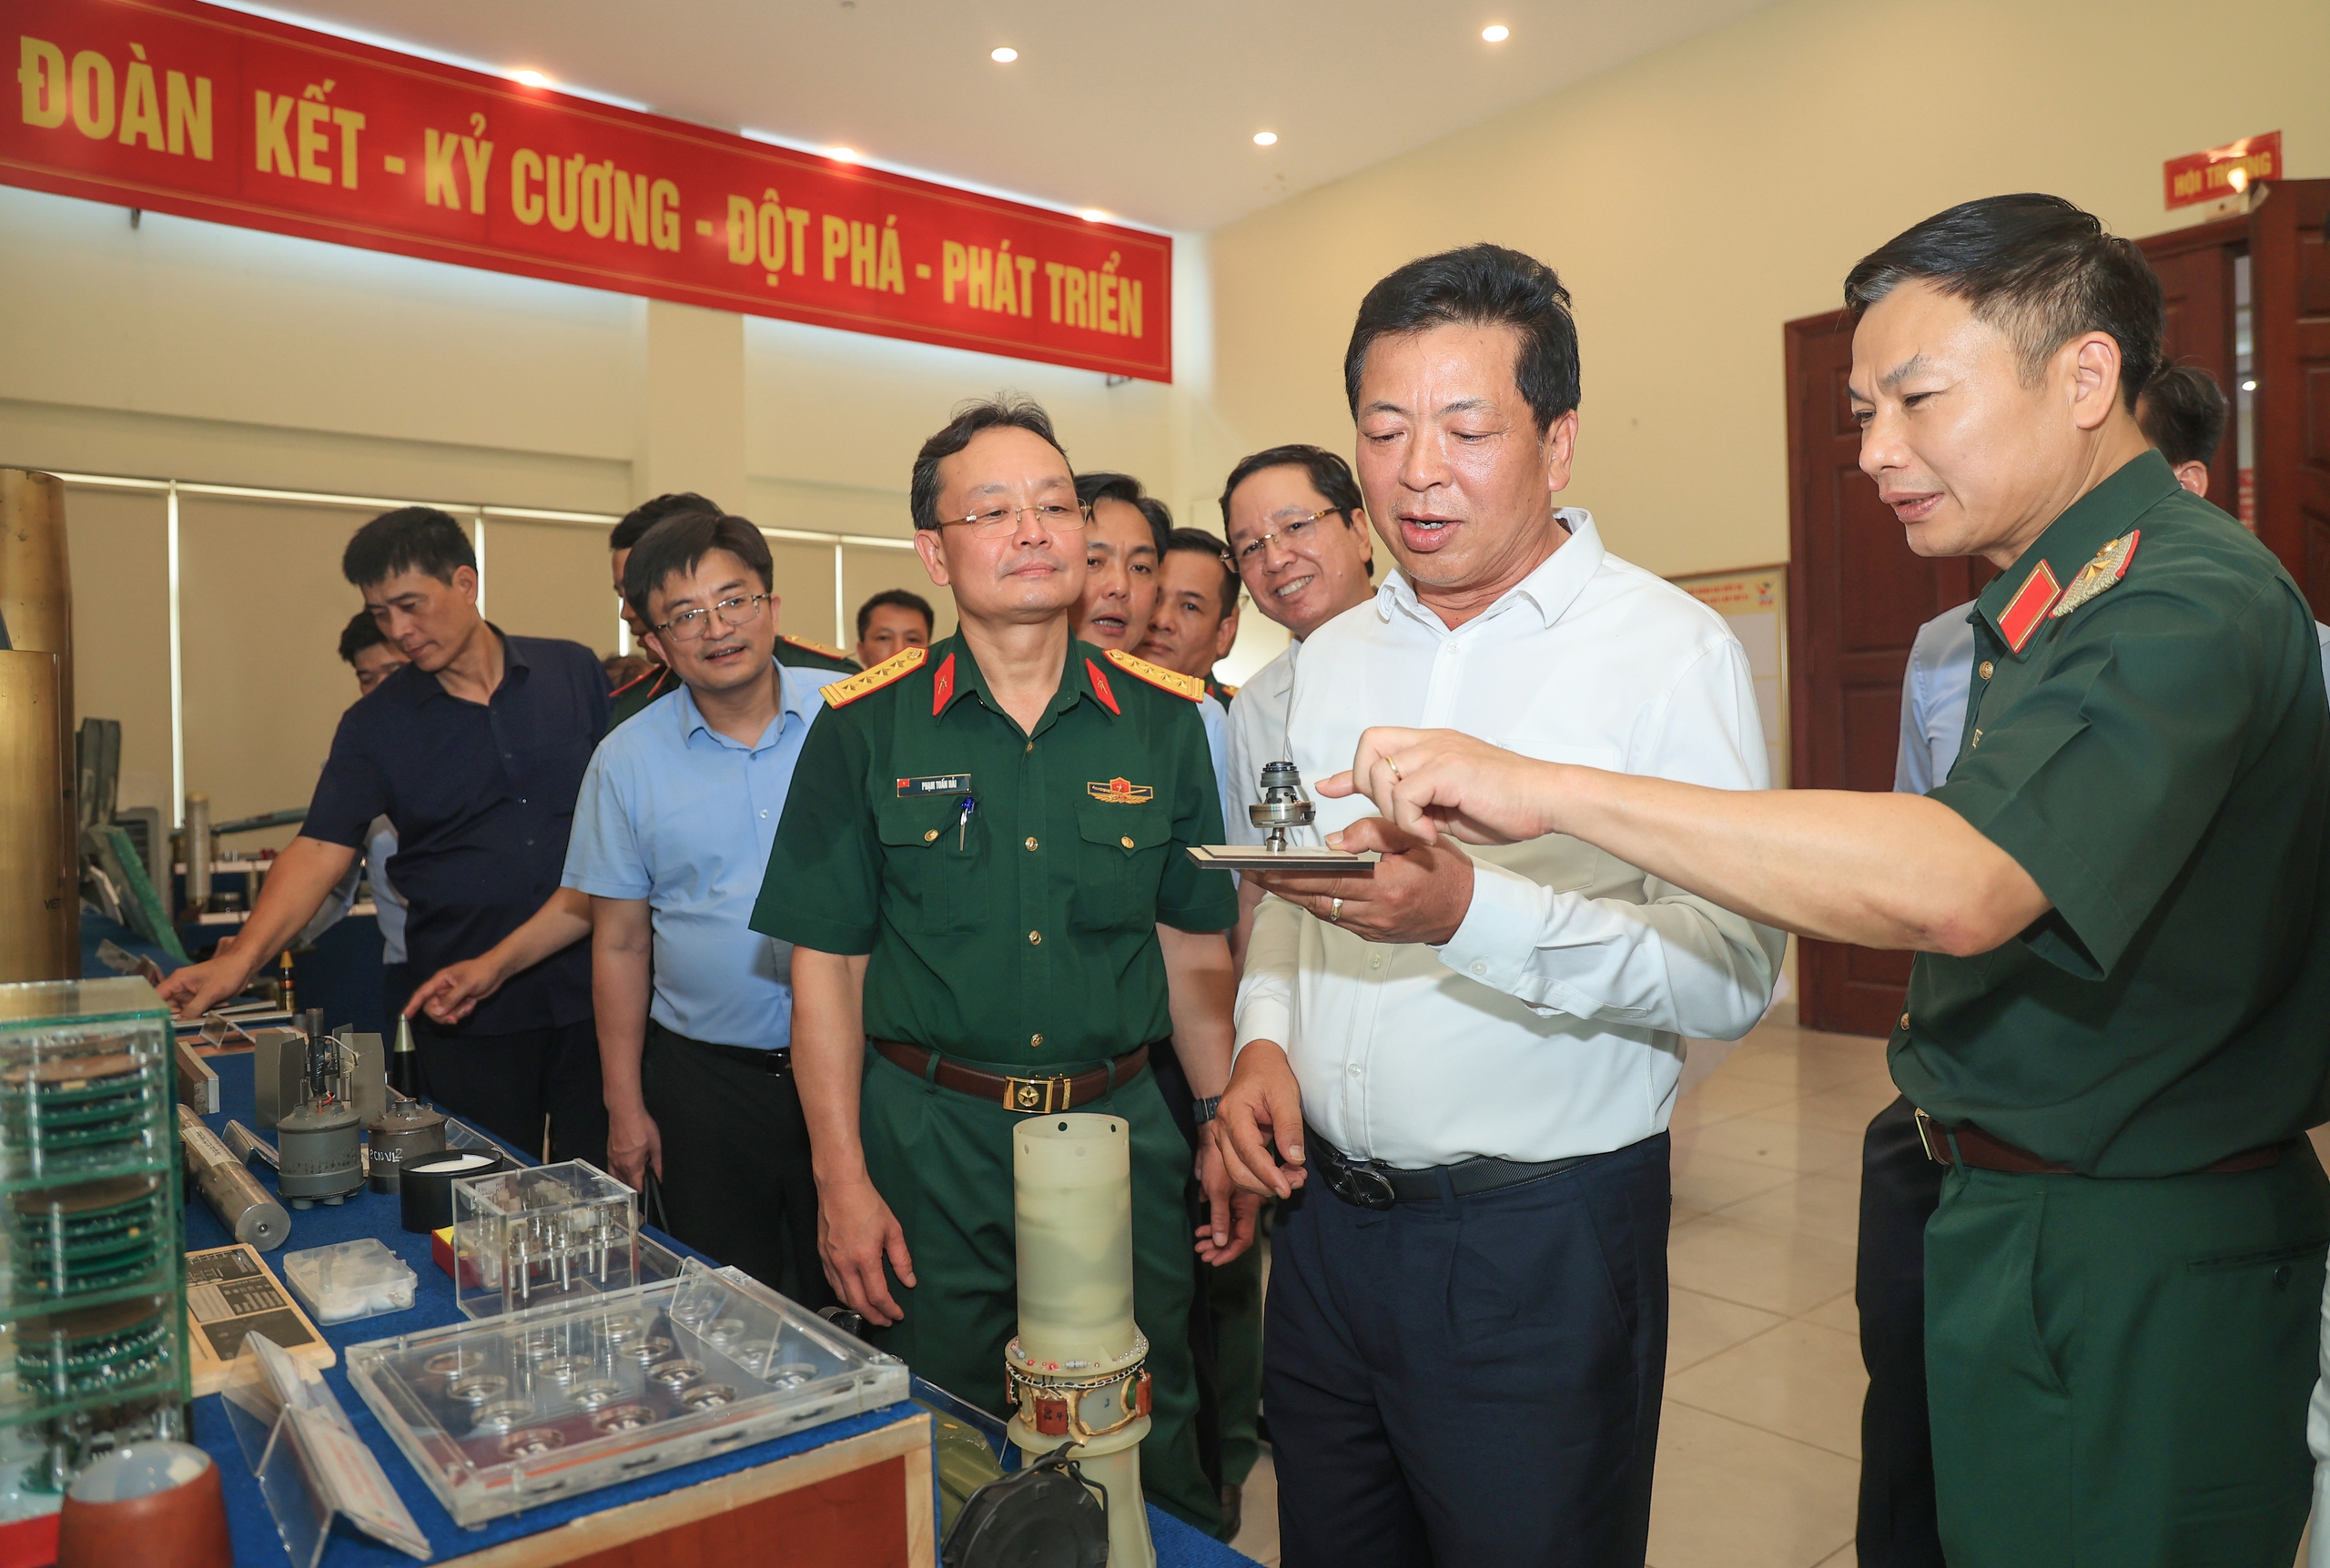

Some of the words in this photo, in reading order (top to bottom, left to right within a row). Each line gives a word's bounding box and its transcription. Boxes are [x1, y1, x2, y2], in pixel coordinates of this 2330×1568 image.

[17, 35, 213, 160] ĐOÀN
[255, 79, 365, 189] KẾT
[424, 113, 492, 215] KỶ
[512, 148, 680, 251] CƯƠNG
[727, 188, 810, 286] ĐỘT
[823, 215, 905, 293] PHÁ
[943, 239, 1036, 317] PHÁT
[1046, 250, 1142, 338] TRIỂN
